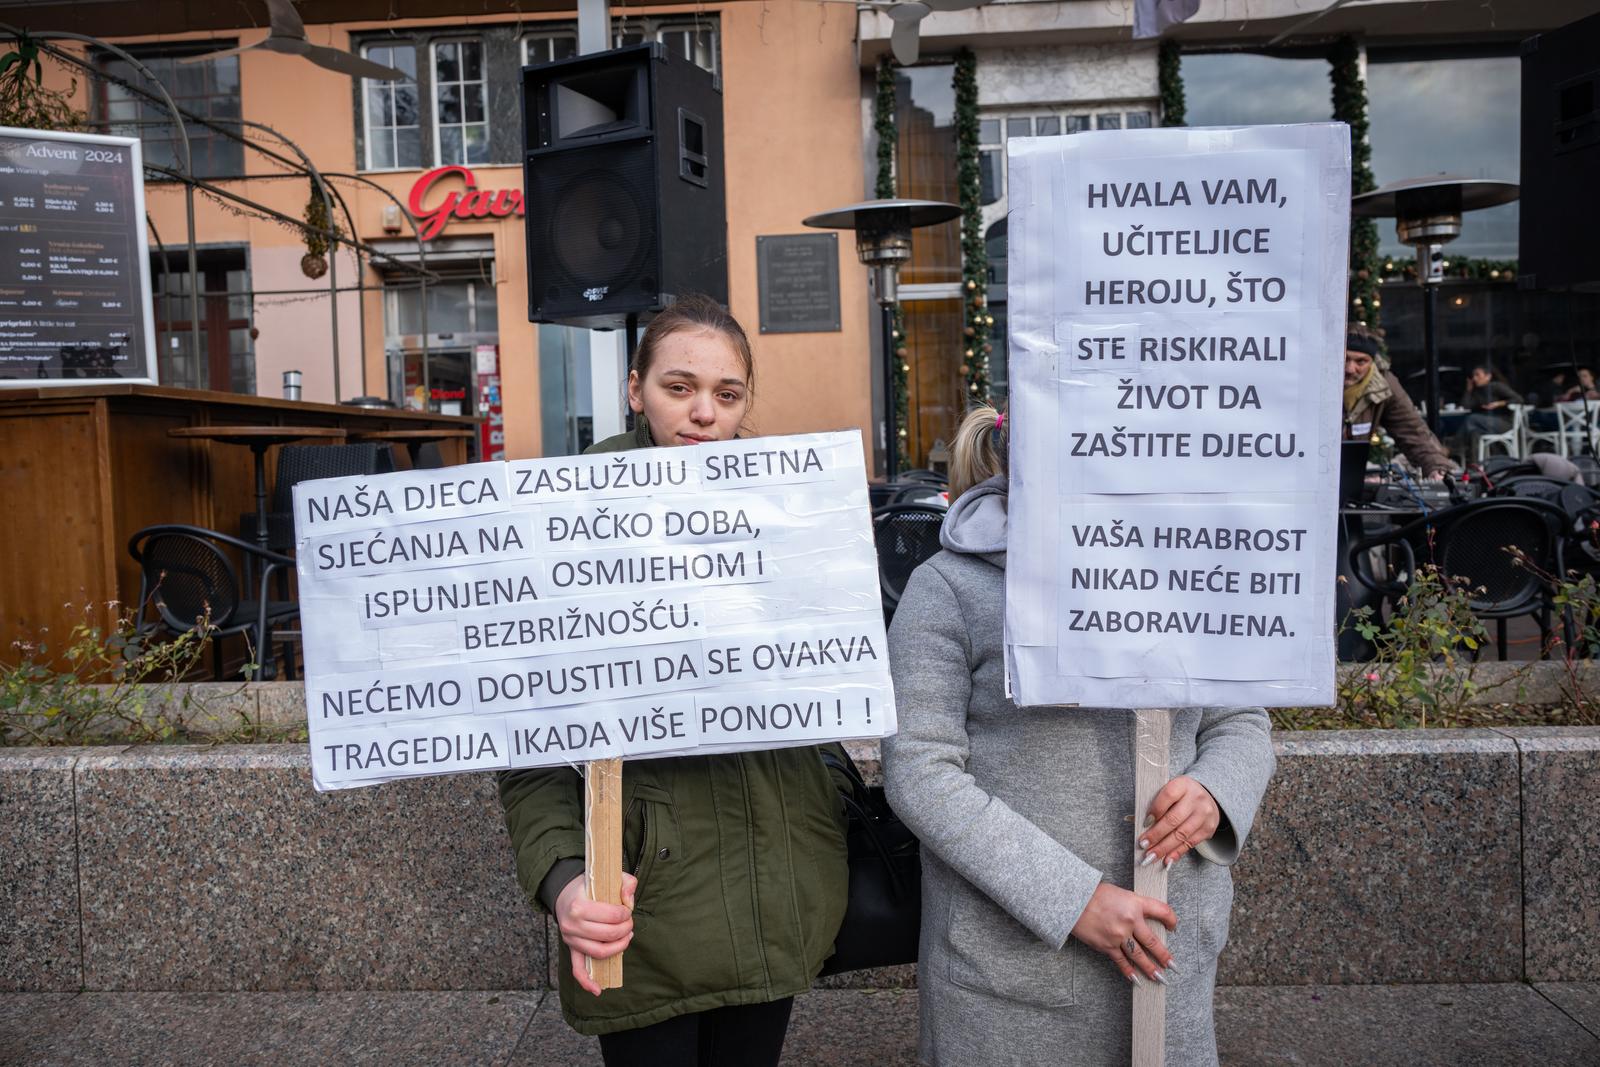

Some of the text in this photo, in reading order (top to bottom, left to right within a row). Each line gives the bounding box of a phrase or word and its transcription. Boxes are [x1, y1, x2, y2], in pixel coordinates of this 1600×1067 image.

[26, 145, 78, 160] Advent
[85, 150, 123, 164] 2024
[1088, 178, 1286, 208] HVALA VAM,
[1104, 225, 1270, 256] UČITELJICE
[1086, 271, 1285, 308] HEROJU, ŠTO
[1078, 337, 1286, 361] STE RISKIRALI
[1117, 379, 1261, 409] ŽIVOT DA
[1071, 426, 1304, 457] ZAŠTITE DJECU.
[308, 448, 823, 523] NAŠA DJECA ZASLUŽUJU SRETNA
[319, 508, 760, 571] SJEĆANJA NA ĐAČKO DOBA,
[1072, 520, 1307, 551] VAŠA HRABROST
[365, 551, 763, 618] ISPUNJENA OSMIJEHOM I
[1072, 565, 1300, 594] NIKAD NEĆE BITI
[464, 599, 698, 649] BEZBRIŽNOŠĆU.
[1069, 610, 1295, 637] ZABORAVLJENA.
[323, 636, 877, 718] NEĆEMO DOPUSTITI DA SE OVAKVA
[324, 698, 871, 771] TRAGEDIJA IKADA VIŠE PONOVI ! !
